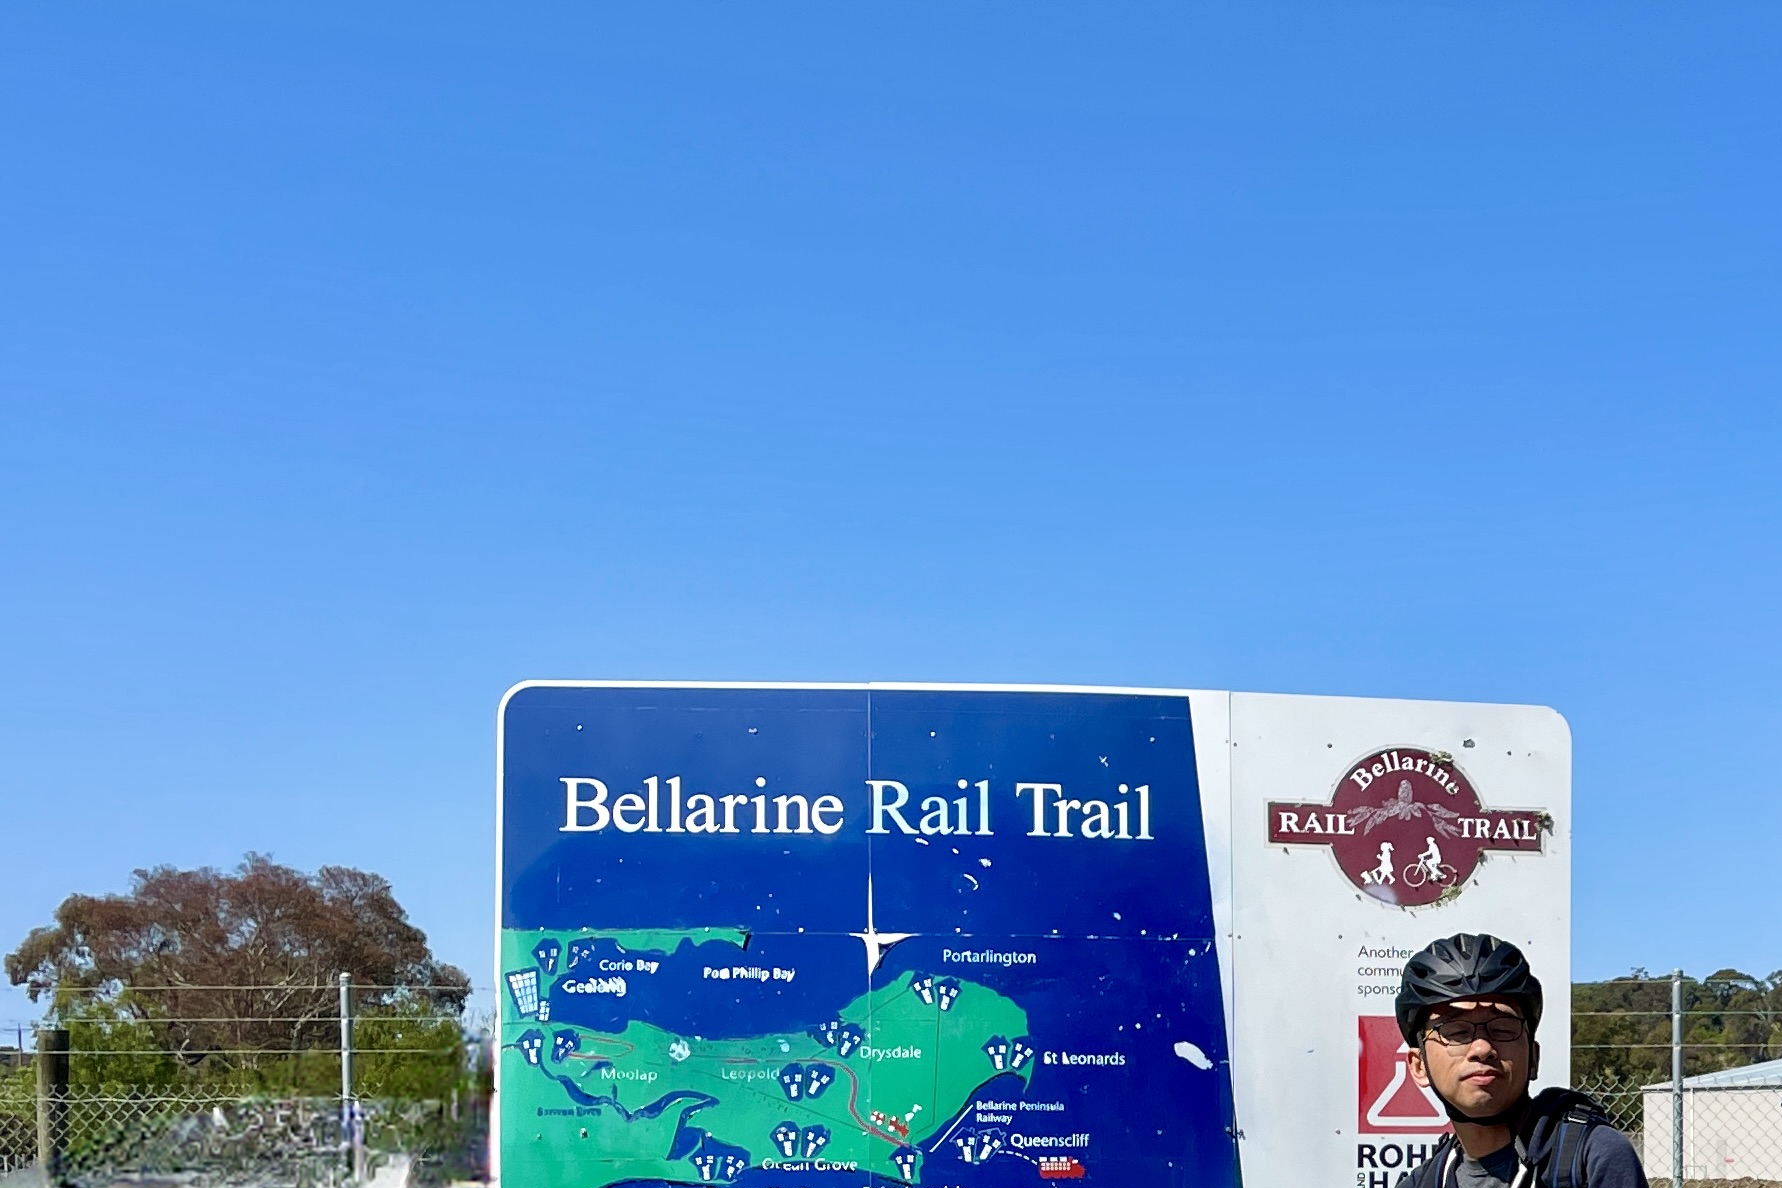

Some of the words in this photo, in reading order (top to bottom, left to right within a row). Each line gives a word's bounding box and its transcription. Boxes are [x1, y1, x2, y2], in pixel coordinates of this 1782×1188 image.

[1350, 751, 1460, 796] Bellarine
[558, 775, 844, 834] Bellarine
[865, 779, 995, 835] Rail
[1015, 782, 1155, 840] Trail
[1278, 812, 1355, 835] RAIL
[1457, 817, 1537, 841] TRAIL
[943, 949, 1037, 966] Portarlington
[1357, 945, 1414, 959] Another
[599, 959, 633, 971] Corio
[860, 1045, 922, 1061] Drysdale
[1043, 1052, 1060, 1066] St
[1062, 1052, 1126, 1066] Leonards
[601, 1068, 658, 1083] Moolap
[722, 1068, 780, 1082] Leopold
[976, 1112, 1013, 1126] Railway
[1010, 1133, 1090, 1149] Queenscliff
[814, 1157, 859, 1172] Grove
